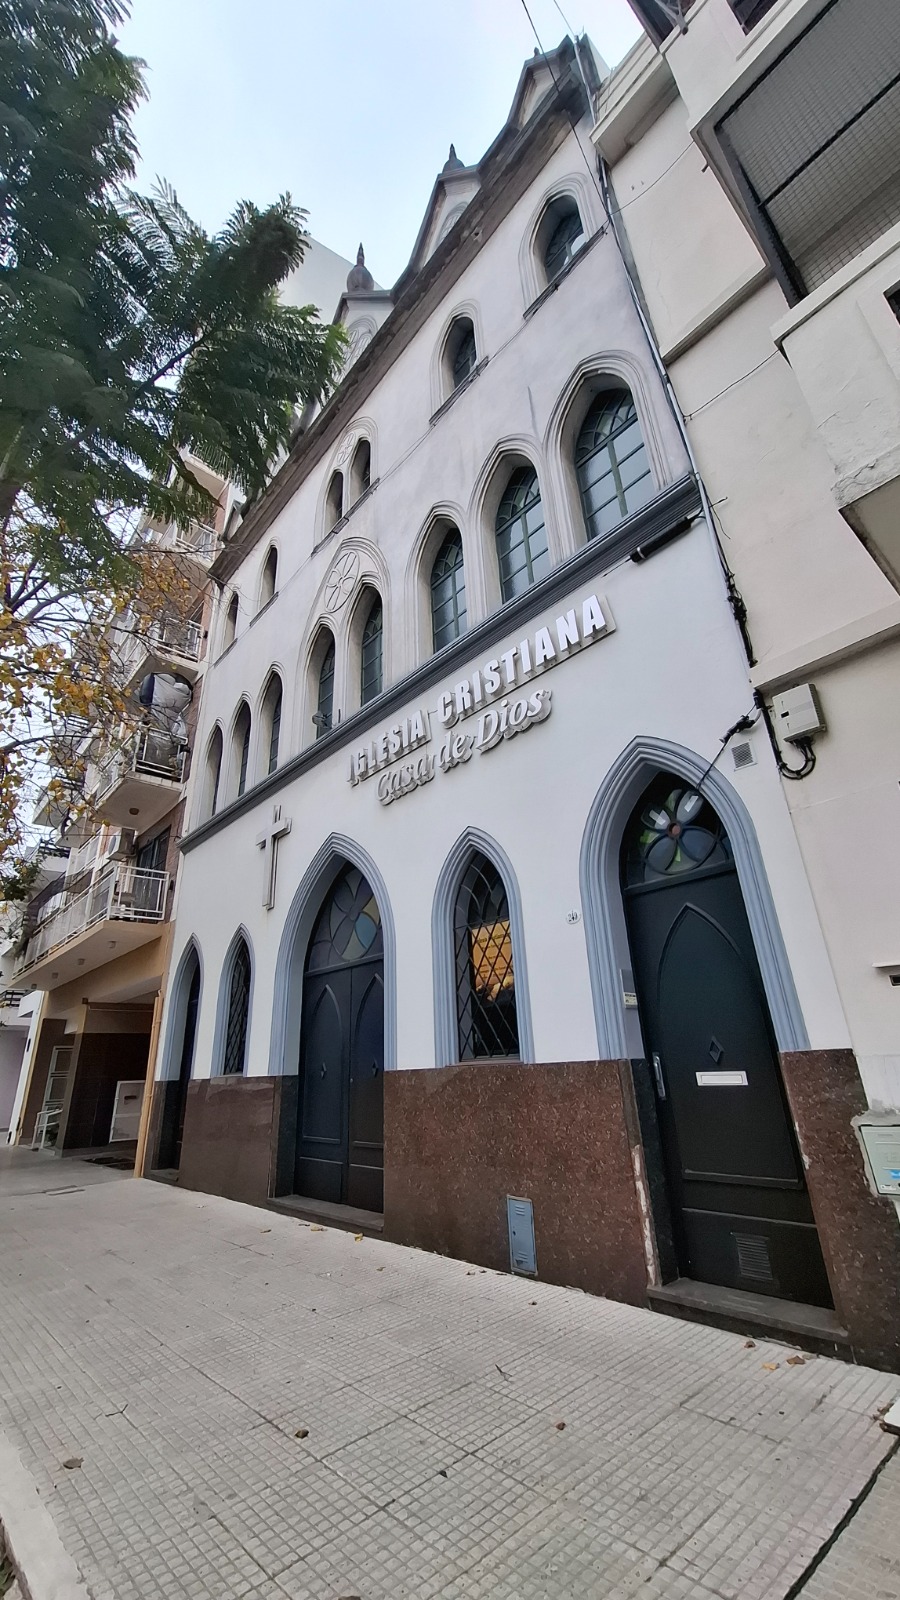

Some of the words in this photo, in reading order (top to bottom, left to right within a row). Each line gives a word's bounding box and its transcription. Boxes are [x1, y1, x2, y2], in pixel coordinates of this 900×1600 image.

[347, 709, 427, 783] IGLESIA
[437, 594, 608, 724] CRISTIANA
[376, 753, 436, 804] Casa
[439, 731, 474, 772] de
[475, 689, 552, 752] Dios
